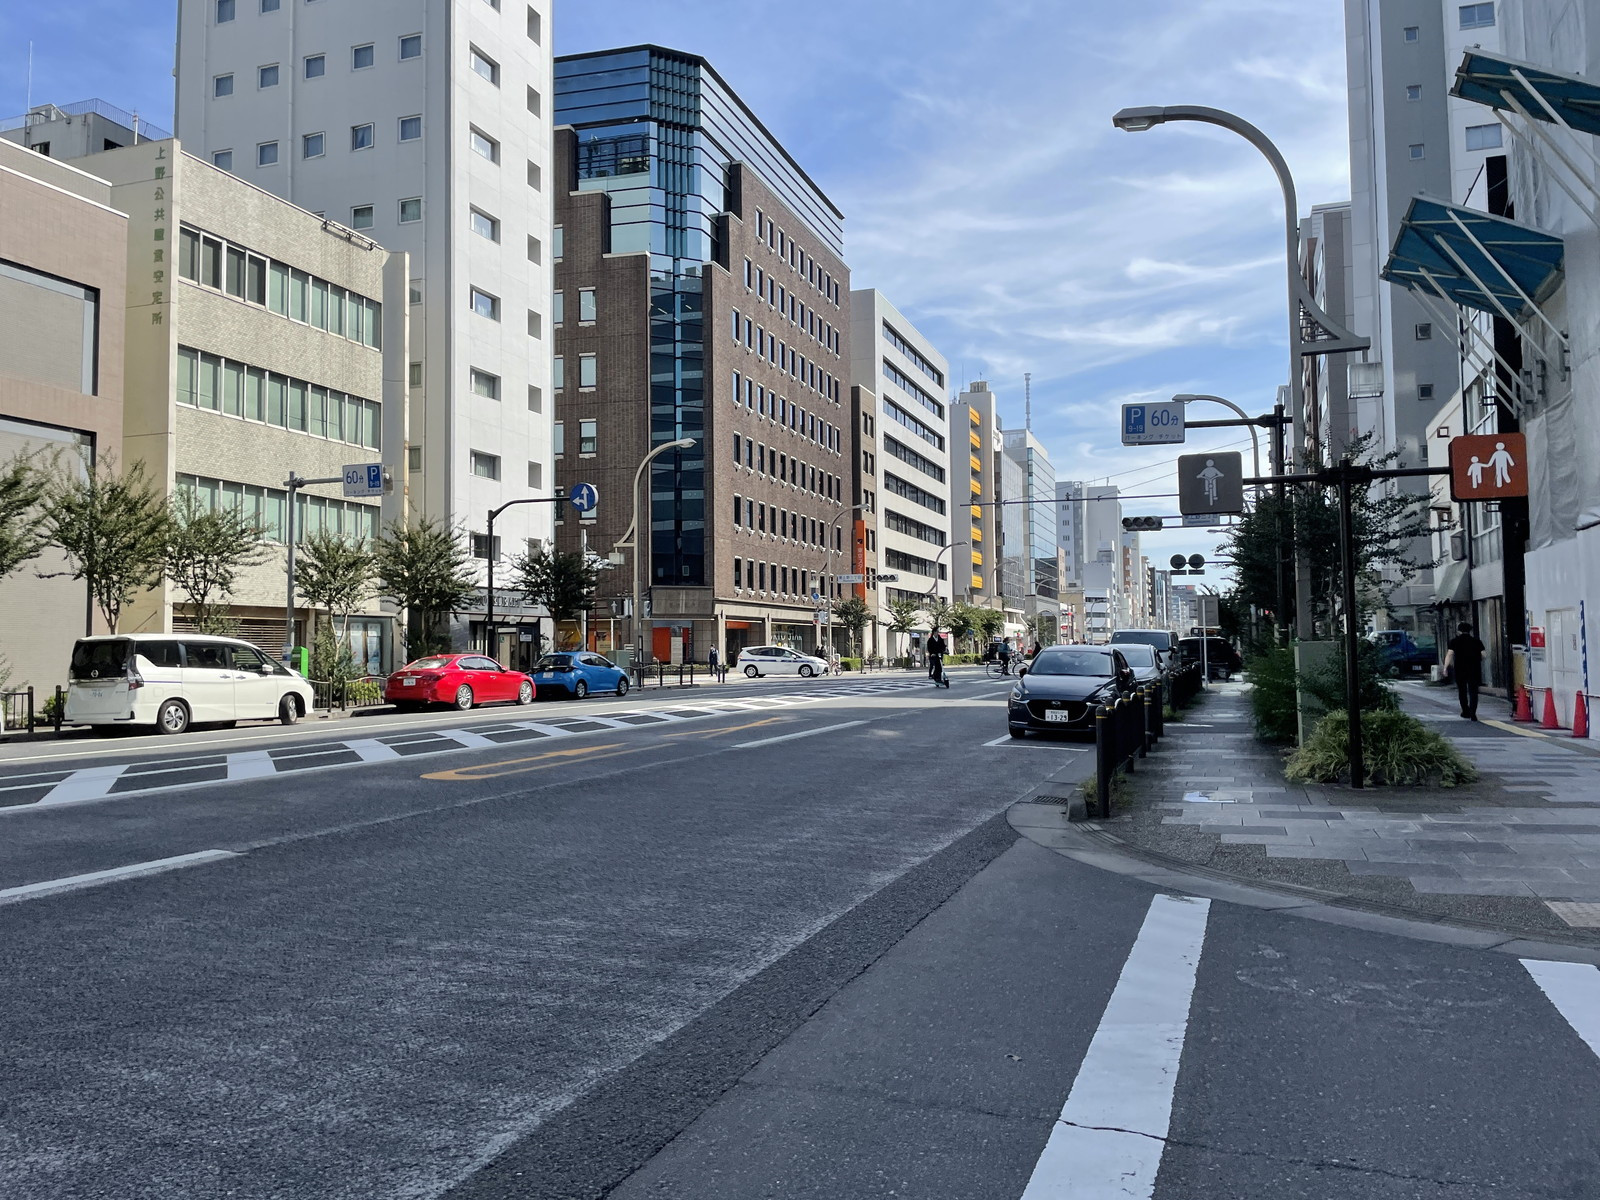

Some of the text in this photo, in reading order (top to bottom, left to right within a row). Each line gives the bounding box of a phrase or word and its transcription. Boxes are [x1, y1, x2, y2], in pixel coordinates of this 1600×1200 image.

[1131, 408, 1142, 424] P
[1151, 409, 1179, 426] 60分
[346, 470, 364, 484] 60分
[370, 467, 378, 480] P
